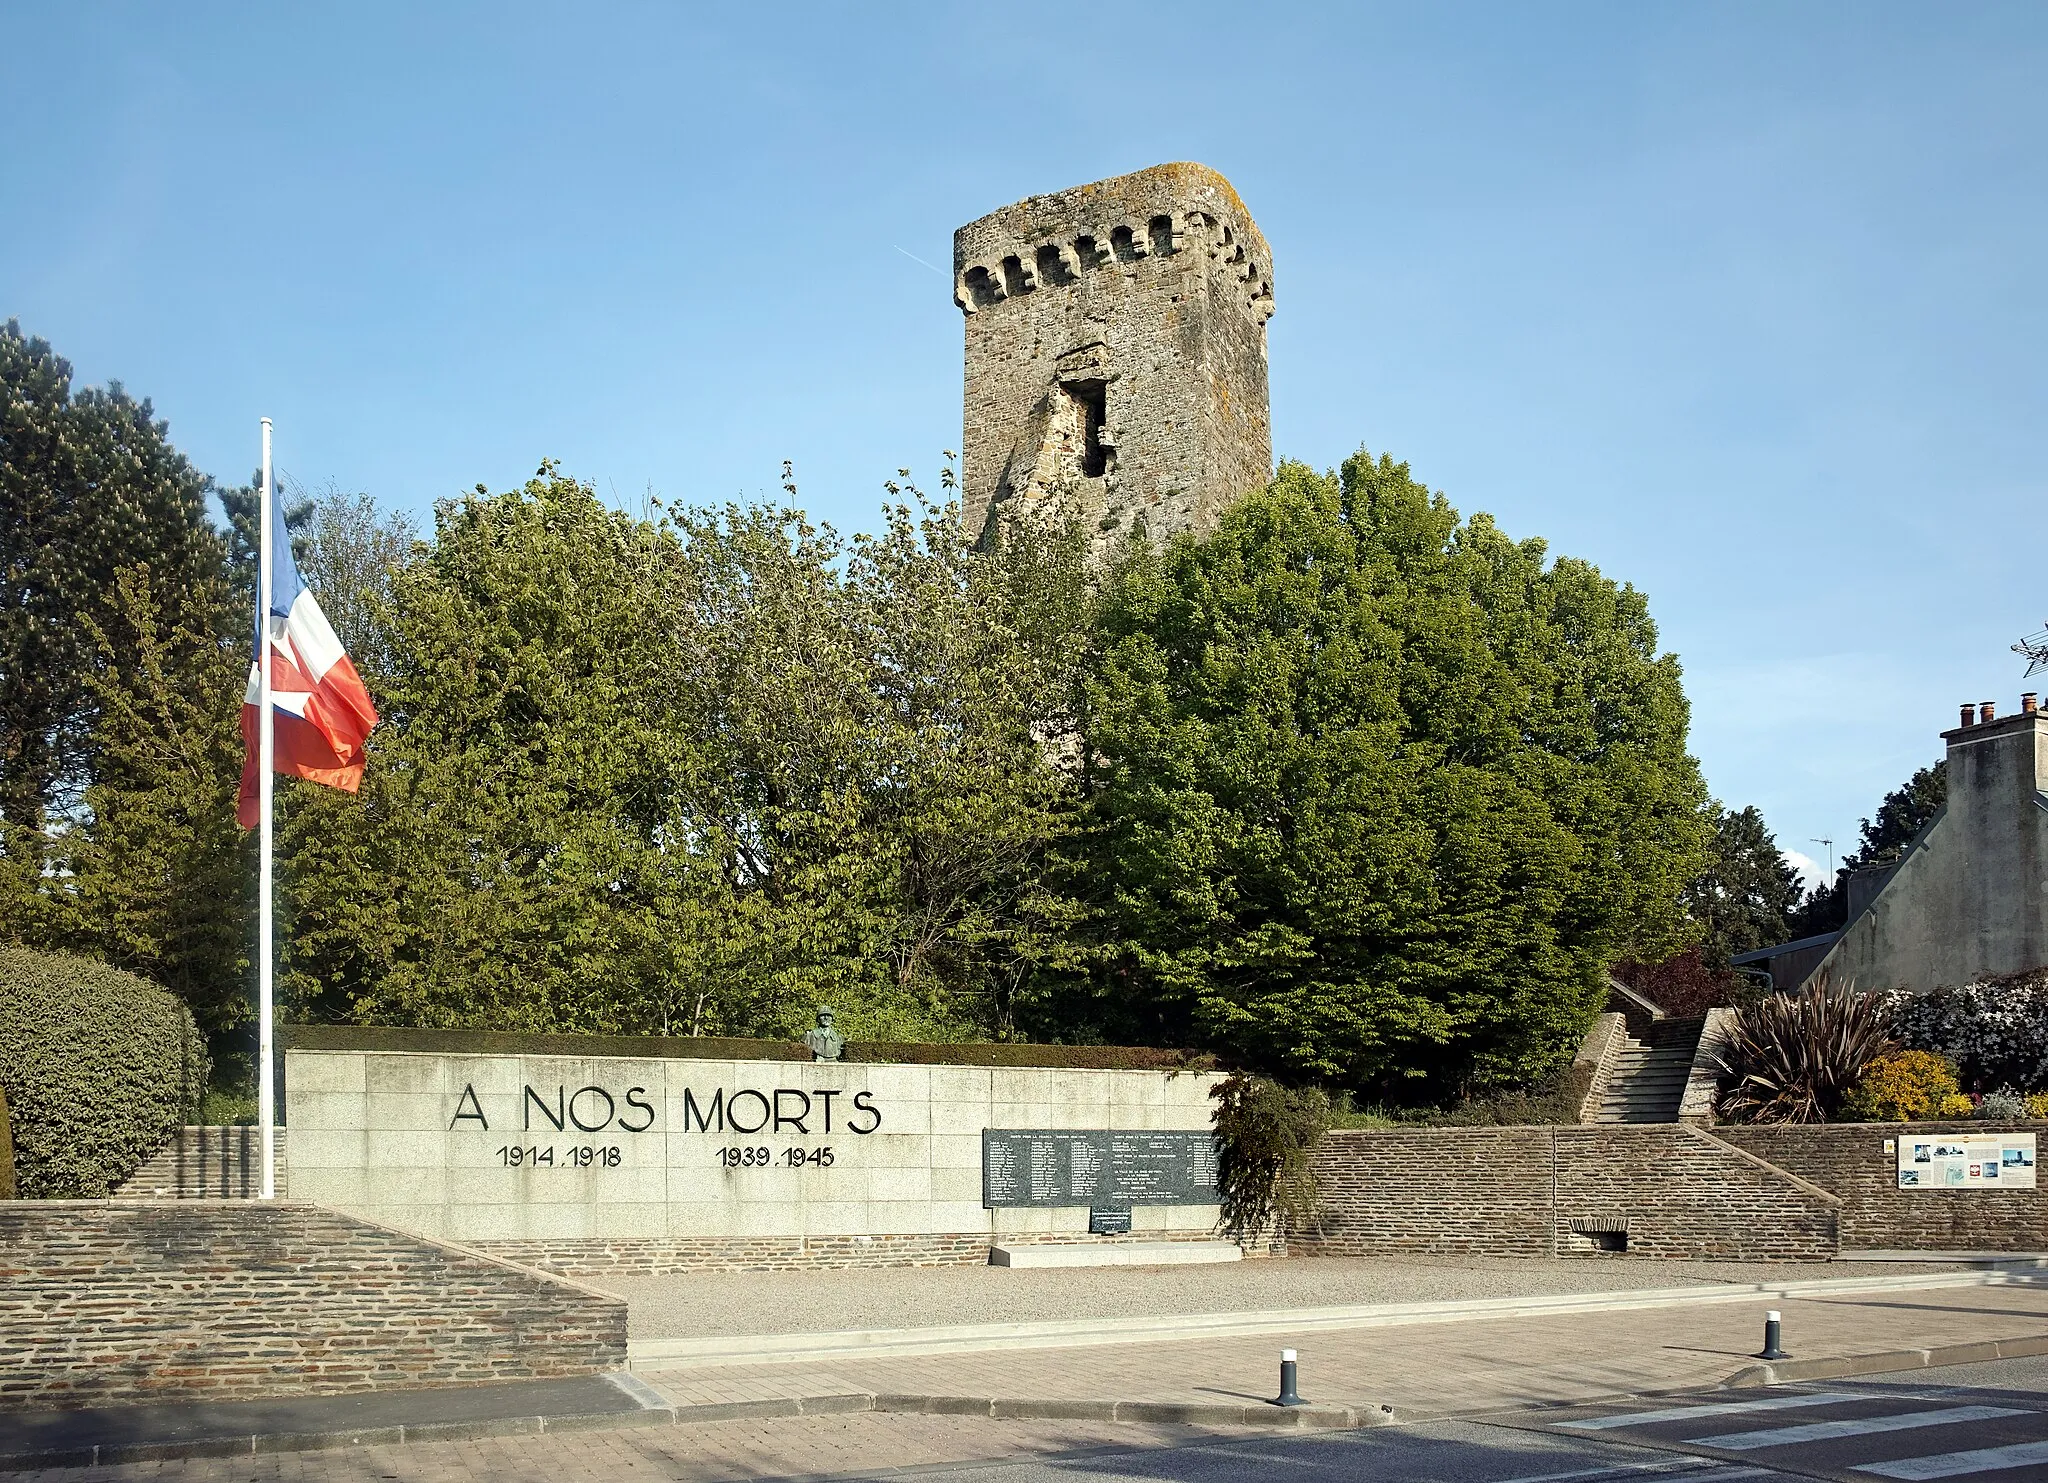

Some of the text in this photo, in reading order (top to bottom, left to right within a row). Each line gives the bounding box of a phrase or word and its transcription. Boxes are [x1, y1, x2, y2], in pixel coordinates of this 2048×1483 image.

[449, 1082, 883, 1135] A NOS MORTS
